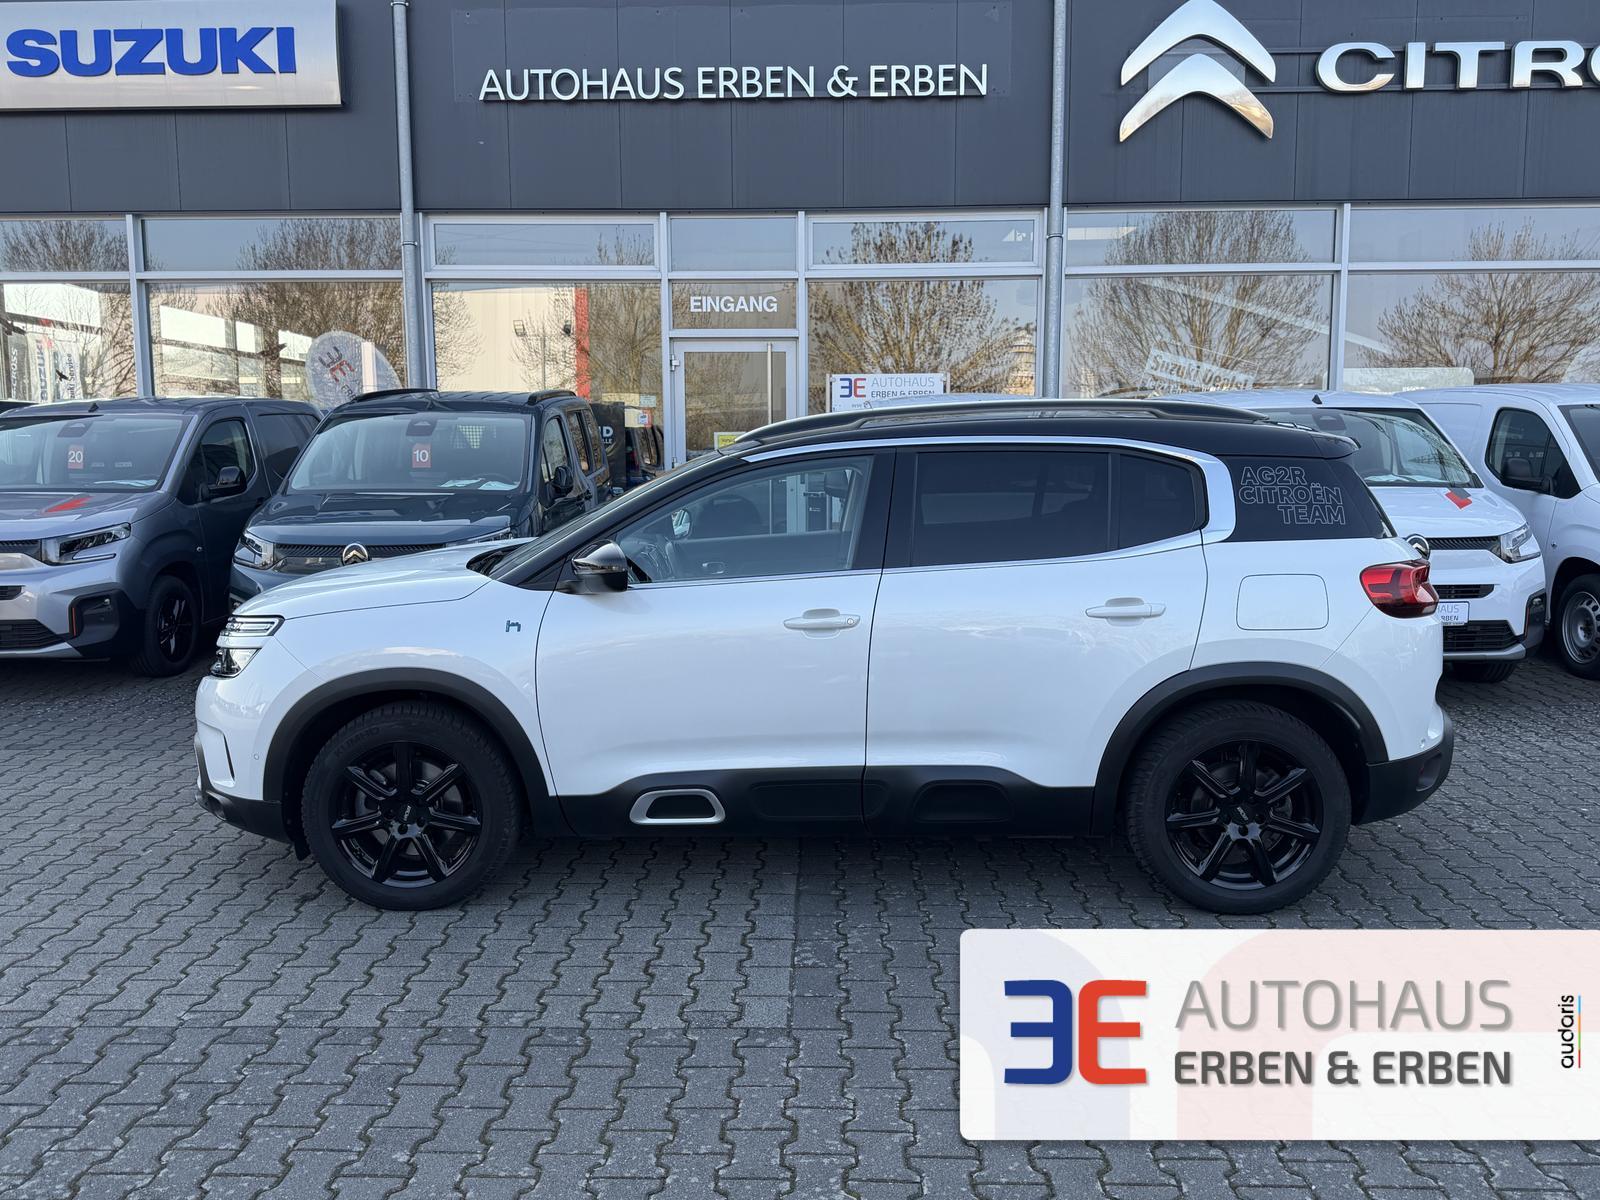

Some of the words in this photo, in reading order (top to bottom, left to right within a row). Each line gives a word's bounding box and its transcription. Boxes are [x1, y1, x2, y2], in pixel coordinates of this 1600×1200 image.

[6, 27, 297, 77] SUZUKI
[1316, 40, 1600, 93] CITR
[479, 67, 684, 101] AUTOHAUS
[697, 66, 815, 98] ERBEN
[827, 65, 858, 97] &
[869, 63, 988, 96] ERBEN
[690, 296, 778, 312] EINGANG
[66, 353, 75, 381] Service
[871, 377, 935, 387] AUTOHAUS
[68, 450, 83, 463] 20
[413, 449, 429, 462] 10
[1240, 466, 1307, 485] AG2R
[1239, 482, 1343, 504] CITROËN
[1277, 504, 1346, 525] TEAM
